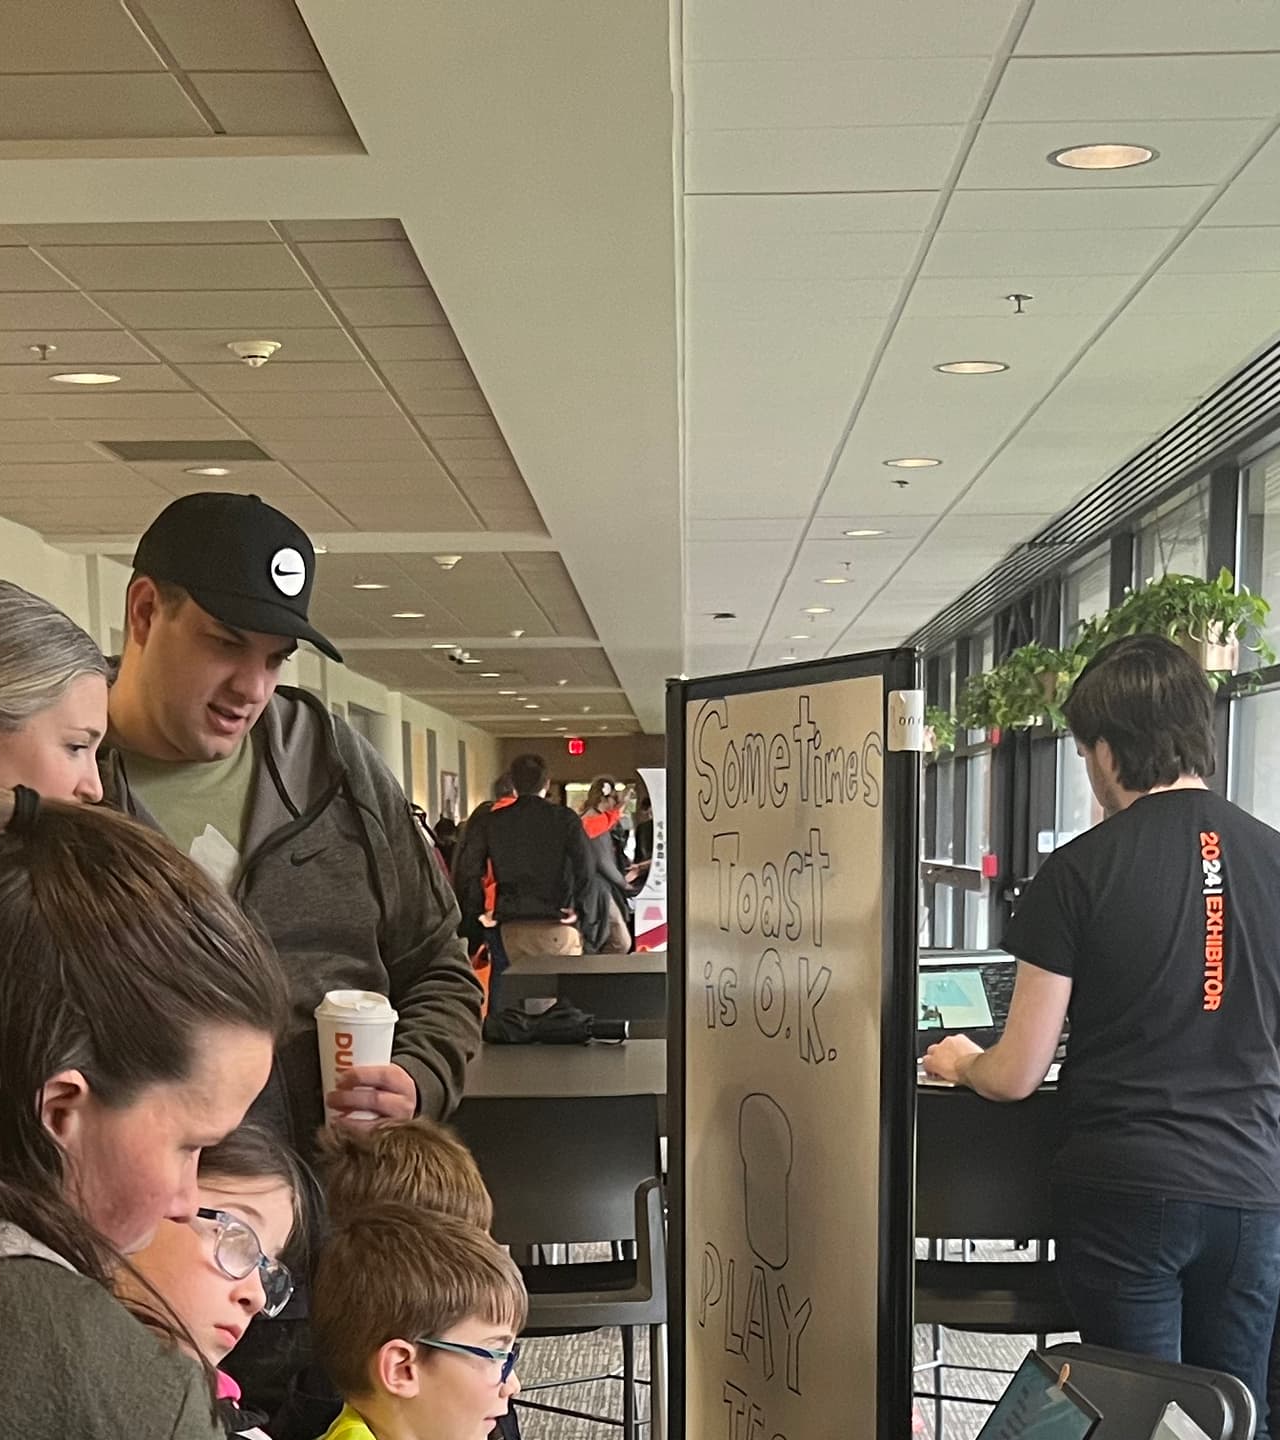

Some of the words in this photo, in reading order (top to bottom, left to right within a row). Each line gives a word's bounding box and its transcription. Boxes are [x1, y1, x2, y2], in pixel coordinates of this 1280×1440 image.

[693, 695, 882, 822] Sometimes
[711, 828, 829, 946] Toast
[704, 961, 738, 1029] is
[698, 1241, 812, 1396] PLAY
